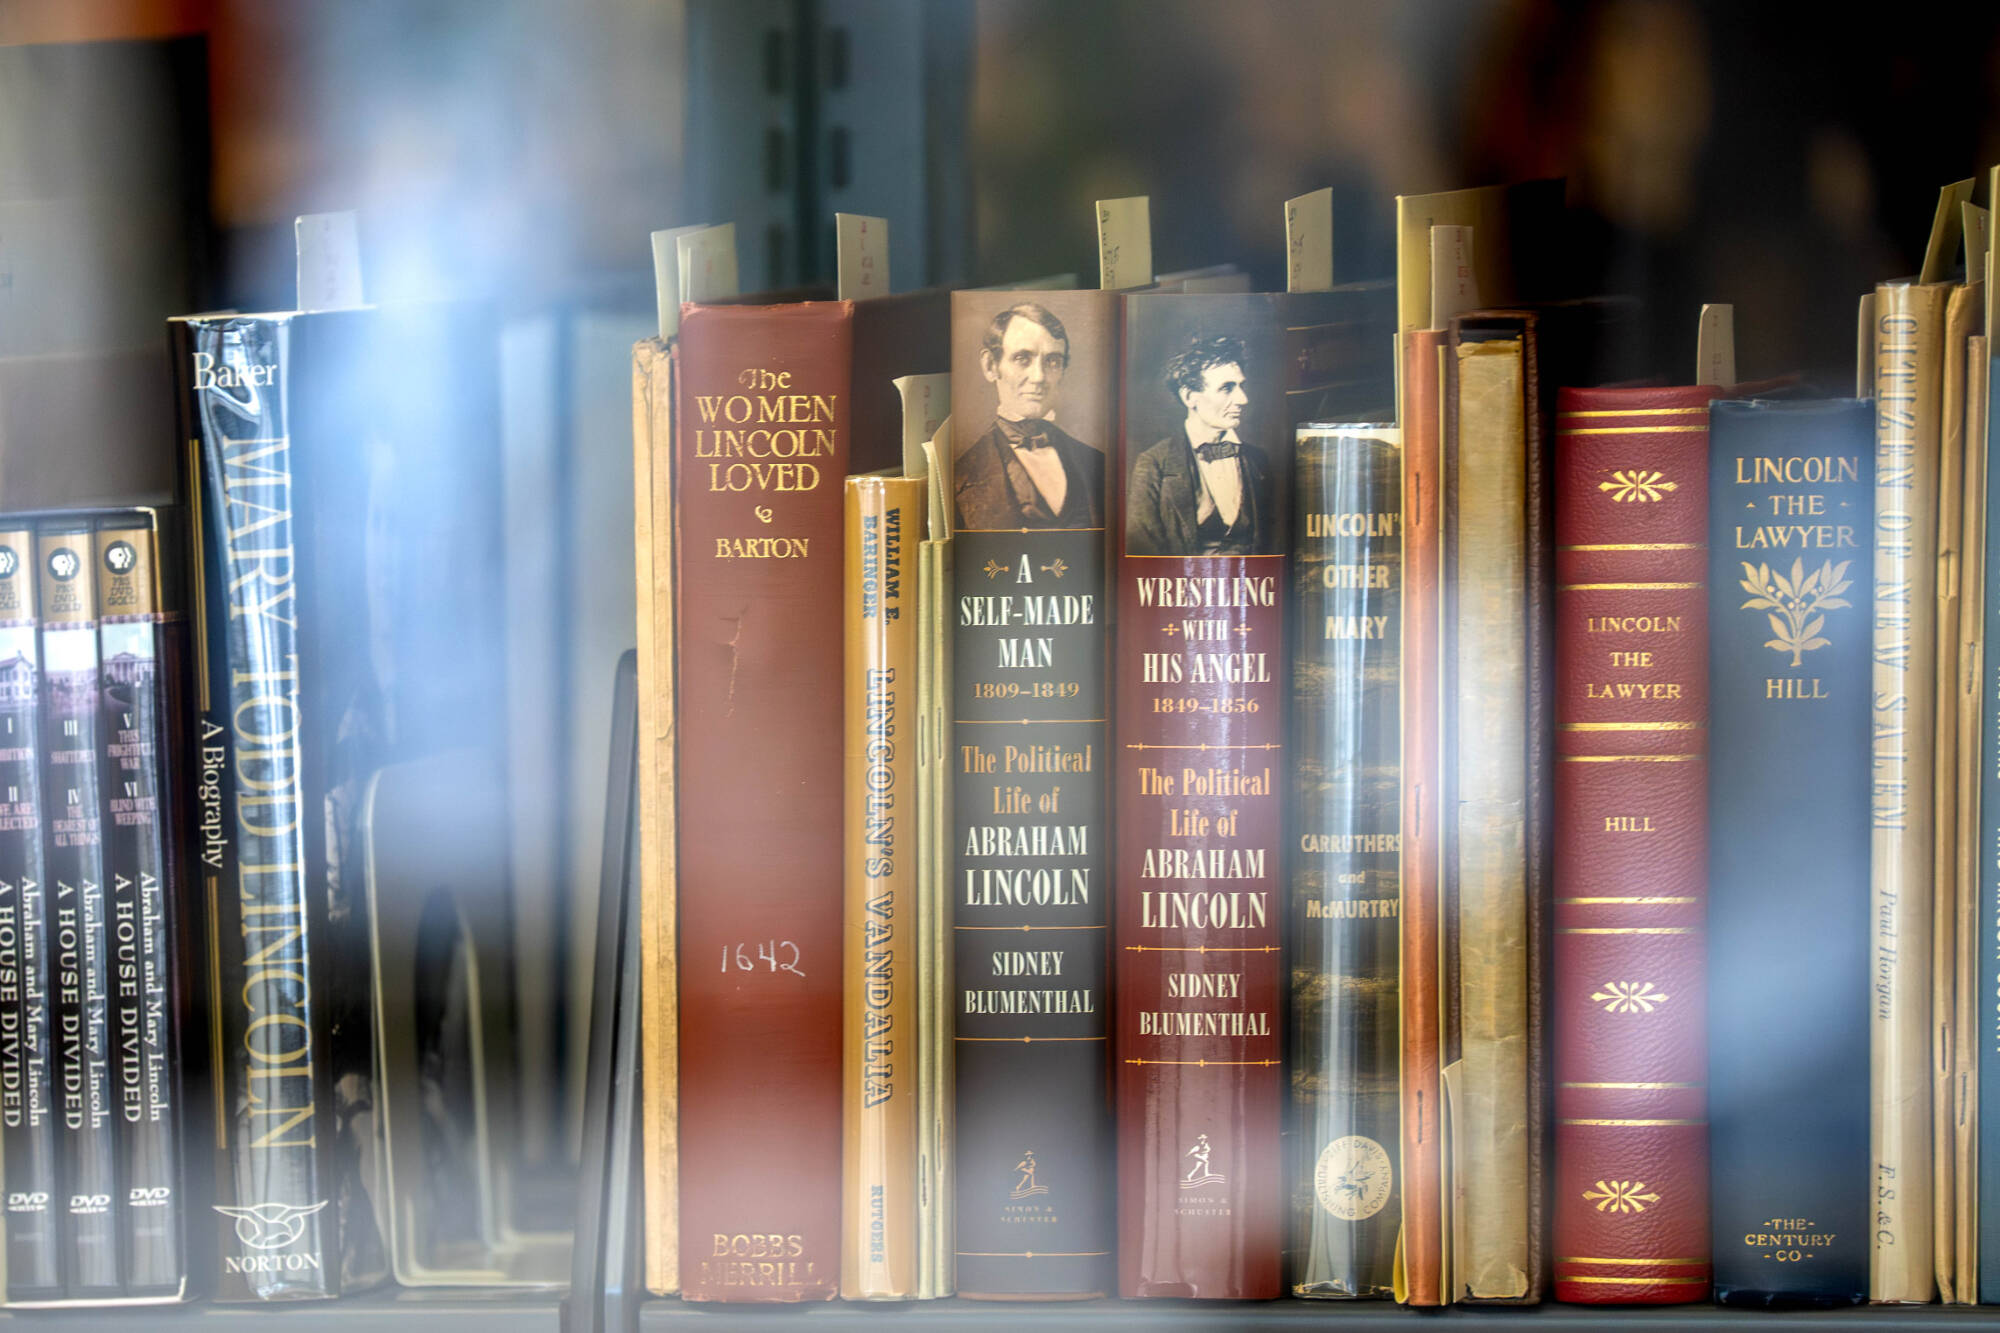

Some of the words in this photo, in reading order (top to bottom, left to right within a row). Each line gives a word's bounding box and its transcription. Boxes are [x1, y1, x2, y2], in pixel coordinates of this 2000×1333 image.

[192, 352, 278, 390] Baker
[738, 368, 792, 391] The
[695, 395, 837, 423] WOMEN
[1878, 313, 1918, 490] CITIZEN
[694, 429, 836, 458] LINCOLN
[708, 463, 820, 492] LOVED
[1736, 456, 1859, 484] LINCOLN
[222, 434, 298, 630] MARY
[1306, 513, 1401, 537] LINCOLN'
[1735, 525, 1859, 550] LAWYER
[1878, 509, 1913, 559] OF
[715, 538, 809, 558] BARTON
[885, 508, 900, 599] WILLIAM
[863, 515, 878, 619] BARINGER
[1015, 553, 1033, 584] A
[1323, 565, 1390, 588] OTHER
[1136, 576, 1276, 608] WRESTLING
[885, 607, 900, 625] E.
[960, 595, 1094, 626] SELF-MADE
[1588, 616, 1681, 633] LINCOLN
[1874, 578, 1912, 672] NEW
[1182, 619, 1228, 641] WITH
[1325, 616, 1388, 640] MARY
[997, 638, 1053, 668] MAN
[1610, 652, 1654, 668] THE
[1142, 652, 1183, 684] HIS
[1190, 652, 1271, 684] ANGEL
[1587, 683, 1682, 700] LAWYER
[1765, 678, 1830, 699] HILL
[64, 720, 78, 736] III
[123, 713, 132, 728] V
[201, 720, 224, 741] A
[232, 653, 303, 837] TODD
[961, 745, 997, 773] The
[1004, 744, 1092, 773] Political
[865, 667, 896, 879] LINCOLN'S
[1872, 691, 1908, 831] SALEM
[124, 781, 138, 798] VI
[1138, 767, 1175, 796] The
[1182, 767, 1271, 796] Political
[68, 788, 81, 805] IV
[198, 746, 228, 868] Biography
[992, 786, 1032, 815] Life
[1039, 786, 1061, 814] of
[1170, 809, 1210, 838] Life
[1217, 809, 1238, 838] of
[1604, 816, 1656, 832] HILL
[965, 826, 1088, 857] ABRAHAM
[1301, 834, 1400, 853] CARRUTHERS
[1140, 848, 1266, 879] ABRAHAM
[1338, 870, 1366, 884] and
[0, 880, 14, 896] A
[57, 880, 75, 899] A
[115, 873, 132, 893] A
[965, 868, 1091, 906] LINCOLN
[22, 876, 41, 960] Abraham
[83, 879, 103, 962] Abraham
[140, 871, 161, 954] Abraham
[1140, 891, 1268, 930] LINCOLN
[1306, 899, 1399, 918] McMURTRY
[1879, 889, 1898, 938] Paul
[0, 906, 18, 1002] HOUSE
[58, 908, 79, 1004] HOUSE
[116, 901, 137, 997] HOUSE
[721, 940, 806, 977] 1642
[144, 960, 164, 994] and
[991, 951, 1064, 977] SIDNEY
[25, 965, 44, 999] and
[86, 966, 105, 1001] and
[1167, 973, 1242, 999] SIDNEY
[1875, 945, 1898, 1022] Horgan
[239, 861, 316, 1149] LINCOLN
[864, 891, 895, 1109] VANDALIA
[964, 989, 1094, 1014] BLUMENTHAL
[24, 1004, 42, 1052] Mary
[84, 1006, 104, 1055] Mary
[144, 1000, 162, 1048] Mary
[1139, 1012, 1271, 1037] BLUMENTHAL
[1, 1012, 22, 1128] DIVIDED
[62, 1014, 83, 1130] DIVIDED
[120, 1007, 142, 1123] DIVIDED
[28, 1058, 48, 1127] Lincoln
[89, 1060, 110, 1129] Lincoln
[148, 1053, 169, 1122] Lincoln
[8, 1192, 49, 1205] DVD
[70, 1194, 111, 1208] DVD
[129, 1187, 170, 1200] DVD
[712, 1234, 803, 1258] BOBBS
[1744, 1234, 1837, 1246] CENTURY
[225, 1252, 322, 1274] NORTON
[701, 1262, 824, 1286] MERRILL
